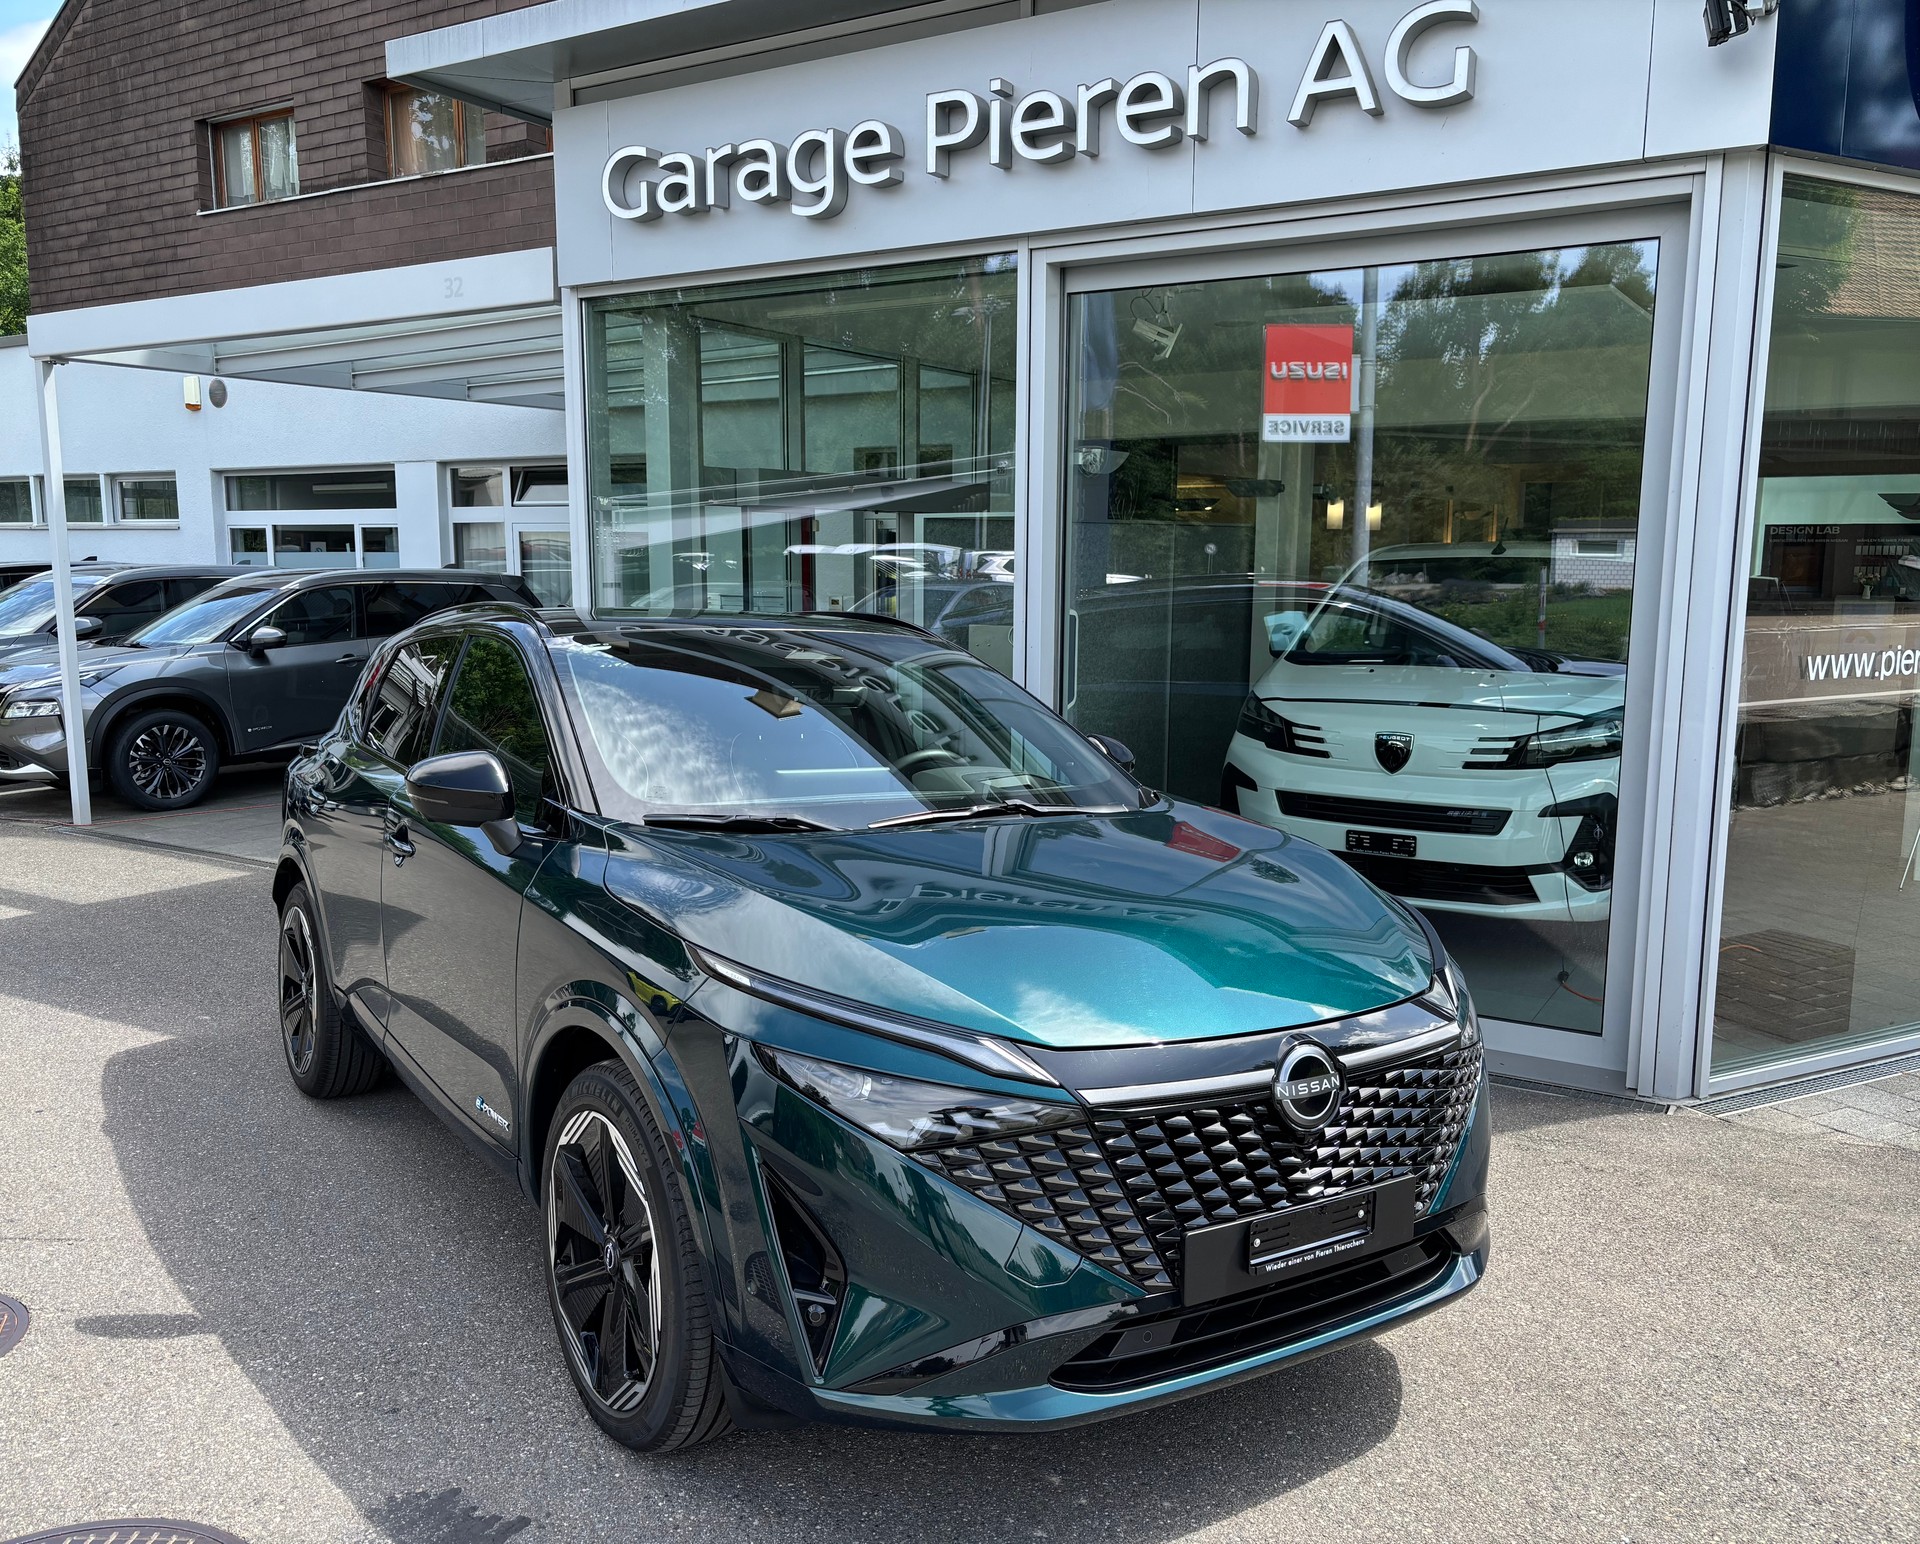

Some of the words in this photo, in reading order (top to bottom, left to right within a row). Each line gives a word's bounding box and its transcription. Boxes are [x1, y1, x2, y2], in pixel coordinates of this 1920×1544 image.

[601, 116, 904, 224] Garage
[926, 57, 1256, 178] Pieren
[1287, 0, 1479, 127] AG
[443, 276, 464, 299] 32
[1770, 526, 1814, 535] DESIGN
[1816, 526, 1841, 535] LAB
[570, 1081, 621, 1112] MICHELIN
[1276, 1074, 1341, 1098] NISSAN
[625, 1116, 647, 1156] PRIMACY
[1265, 1260, 1288, 1272] Wieder
[1288, 1257, 1303, 1266] einer
[1304, 1253, 1315, 1262] von
[1315, 1248, 1333, 1258] Pieren
